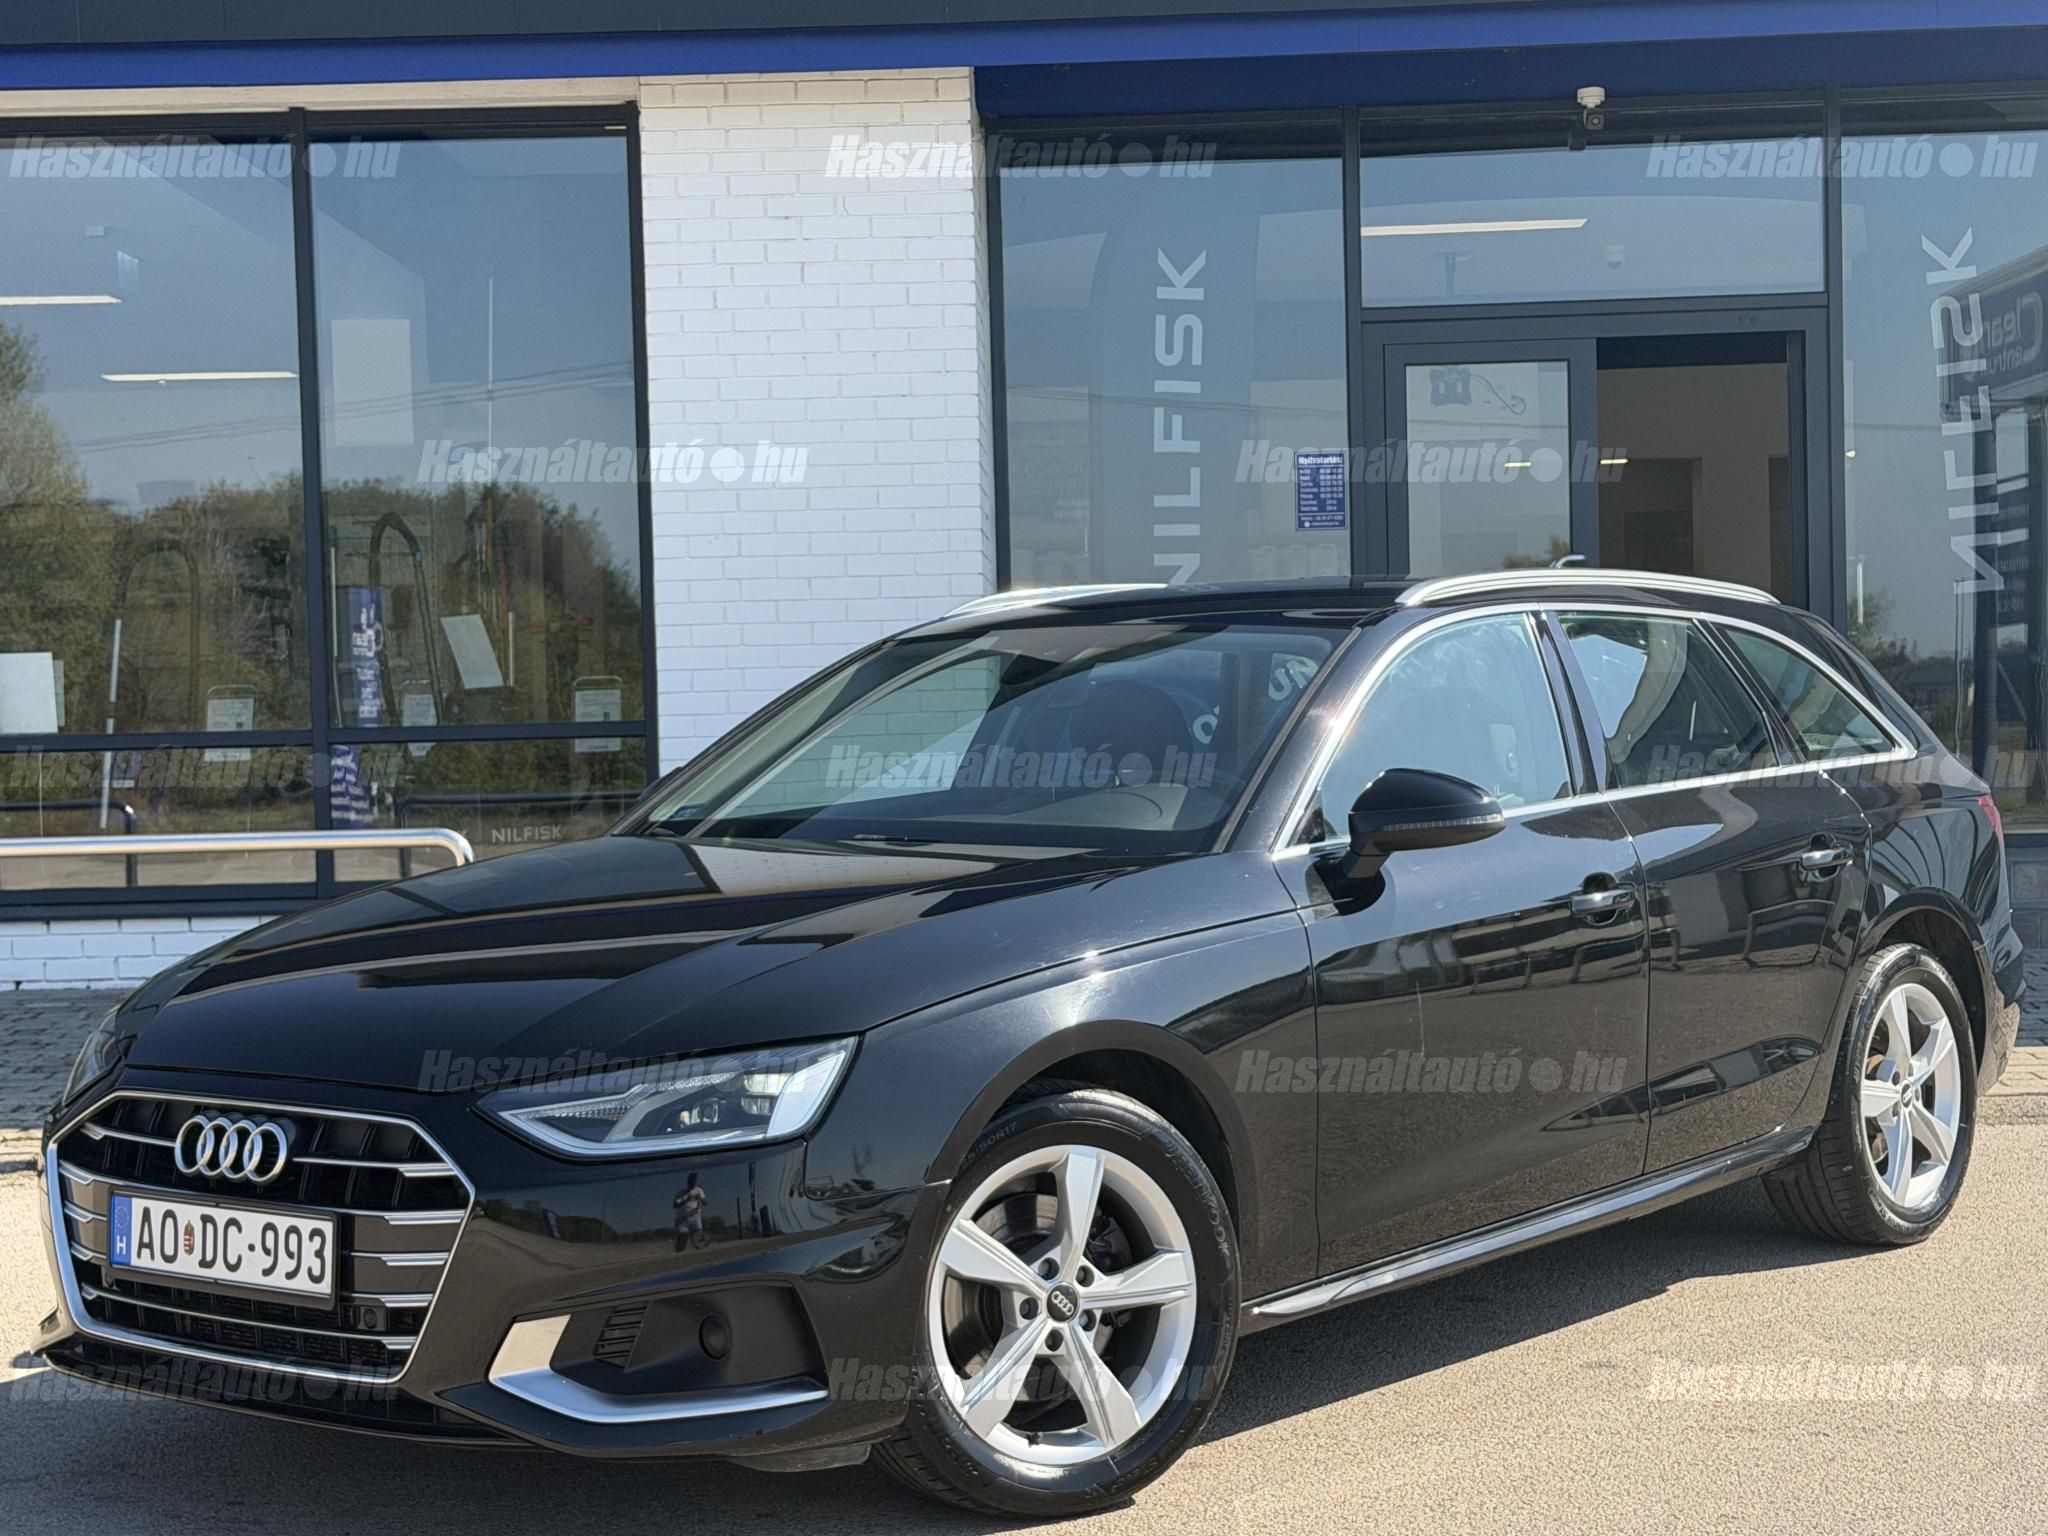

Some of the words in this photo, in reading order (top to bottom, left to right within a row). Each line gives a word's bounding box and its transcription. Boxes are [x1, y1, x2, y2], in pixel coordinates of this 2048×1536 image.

[1153, 247, 1207, 586] NILFISK
[491, 824, 562, 844] NILFISK
[115, 1235, 127, 1256] H
